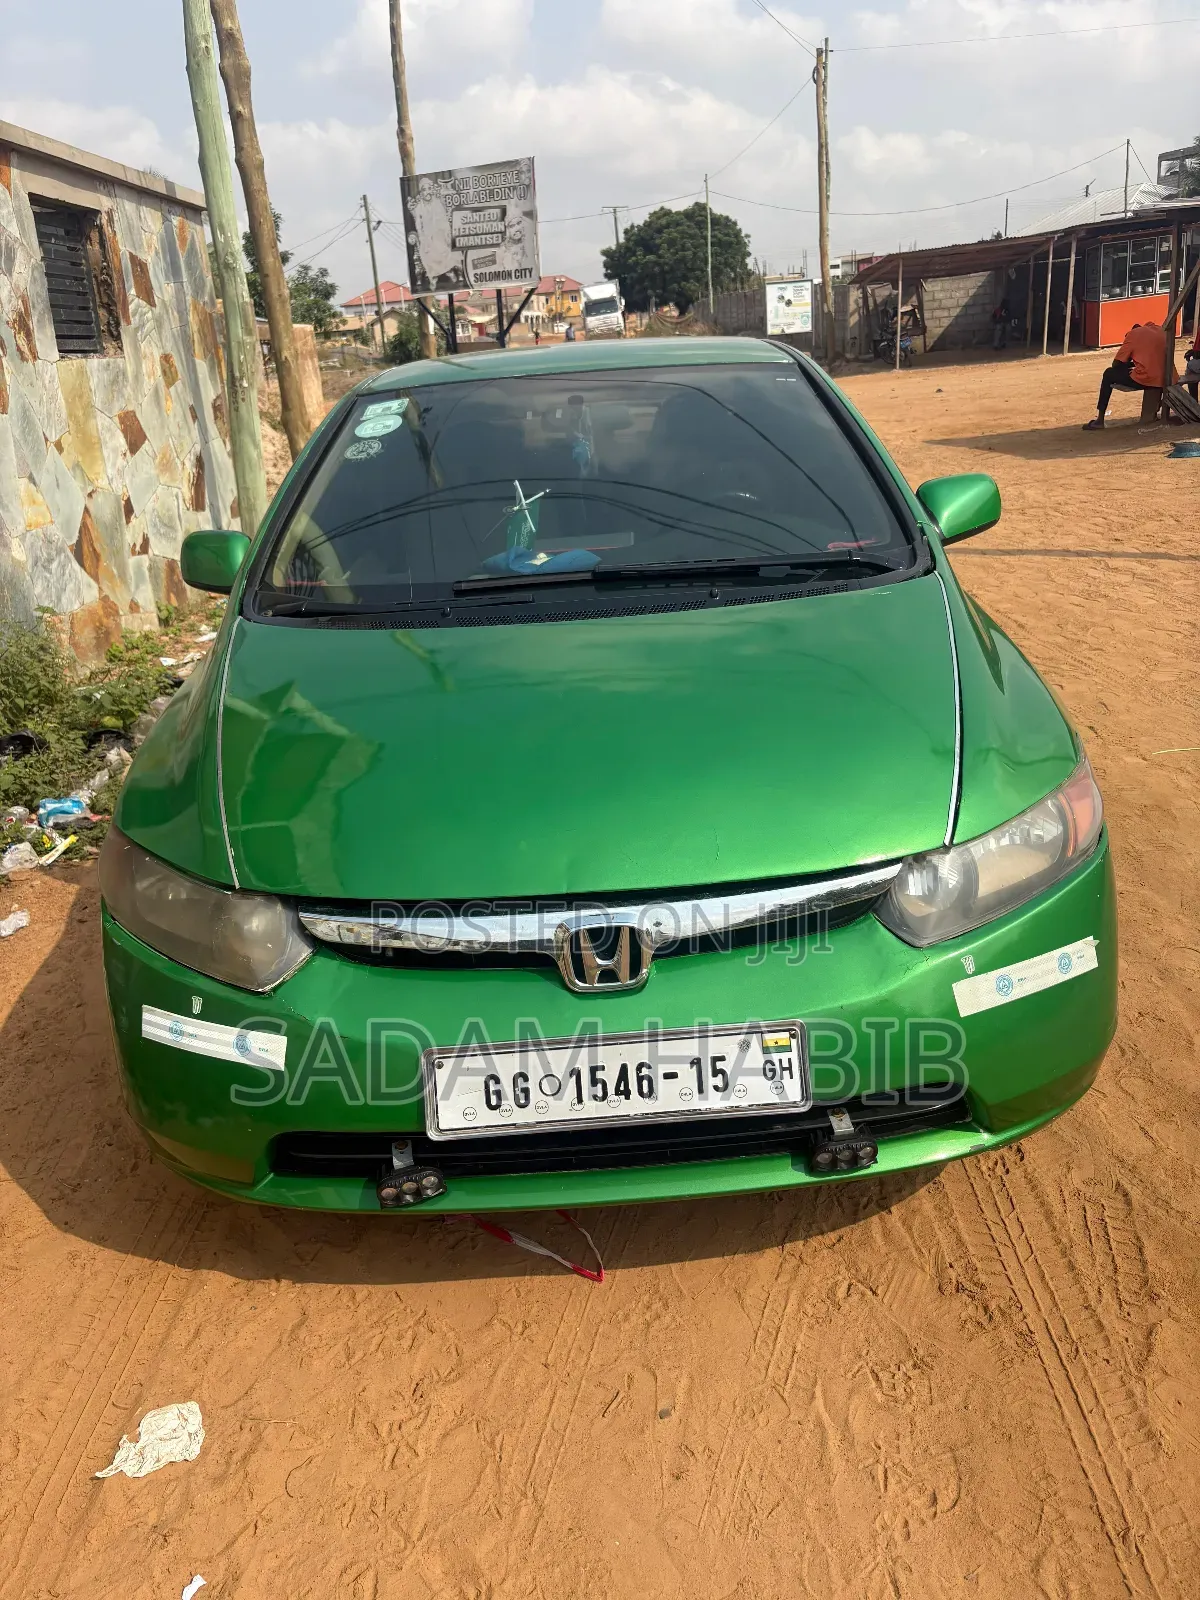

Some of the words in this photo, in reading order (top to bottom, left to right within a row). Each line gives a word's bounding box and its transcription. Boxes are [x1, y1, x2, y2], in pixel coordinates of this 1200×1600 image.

[472, 170, 520, 189] BORTEYE
[473, 270, 512, 283] SOLOMON
[514, 267, 533, 279] CITY
[762, 1057, 794, 1082] GH
[484, 1071, 531, 1111] GG
